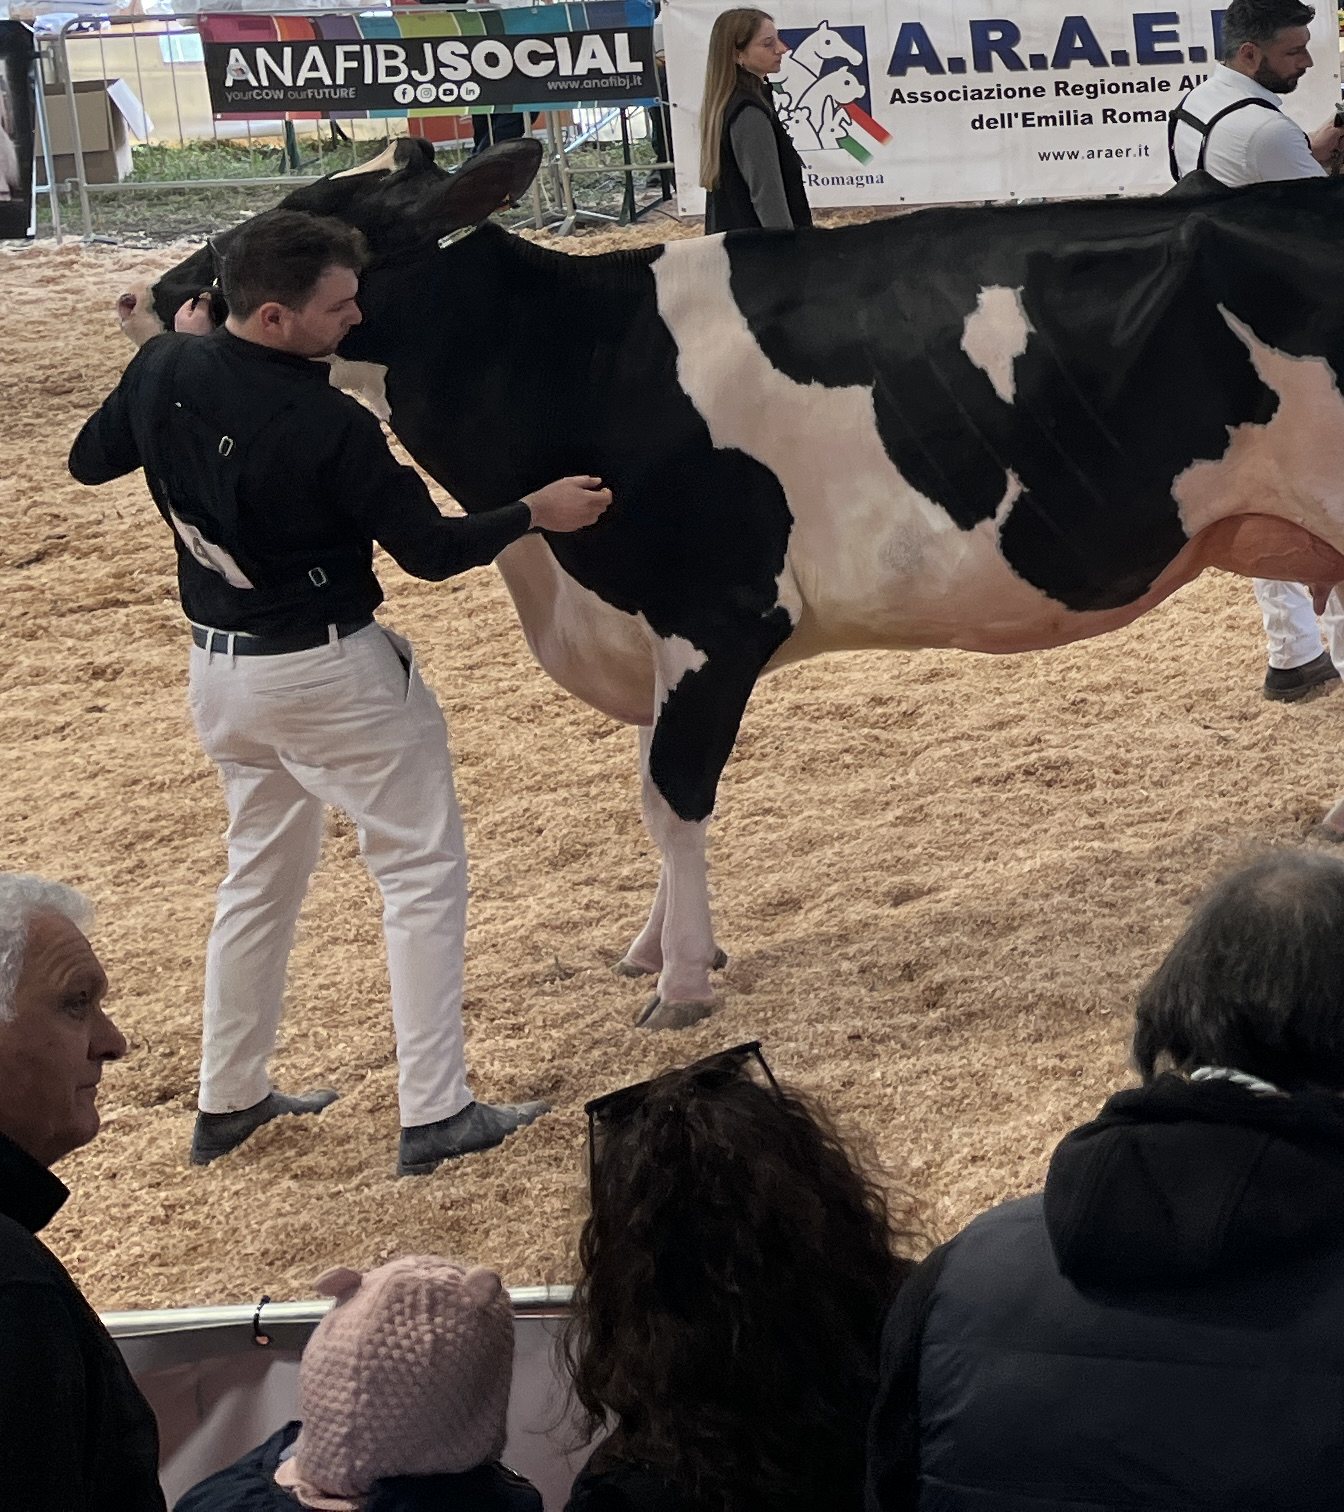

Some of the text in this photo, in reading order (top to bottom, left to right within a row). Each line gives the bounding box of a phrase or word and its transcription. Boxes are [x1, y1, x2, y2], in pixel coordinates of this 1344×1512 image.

[225, 32, 644, 87] ANAFIBJSOCIAL
[547, 74, 643, 90] www.anafibj.it
[889, 84, 1046, 105] Associazione
[1054, 77, 1171, 100] Regionale
[225, 87, 357, 102] yourCOW ourFUTURE
[970, 106, 1170, 131] dell'Emilia Roma
[1037, 144, 1150, 163] www.araer.it
[803, 173, 885, 188] -Romagna
